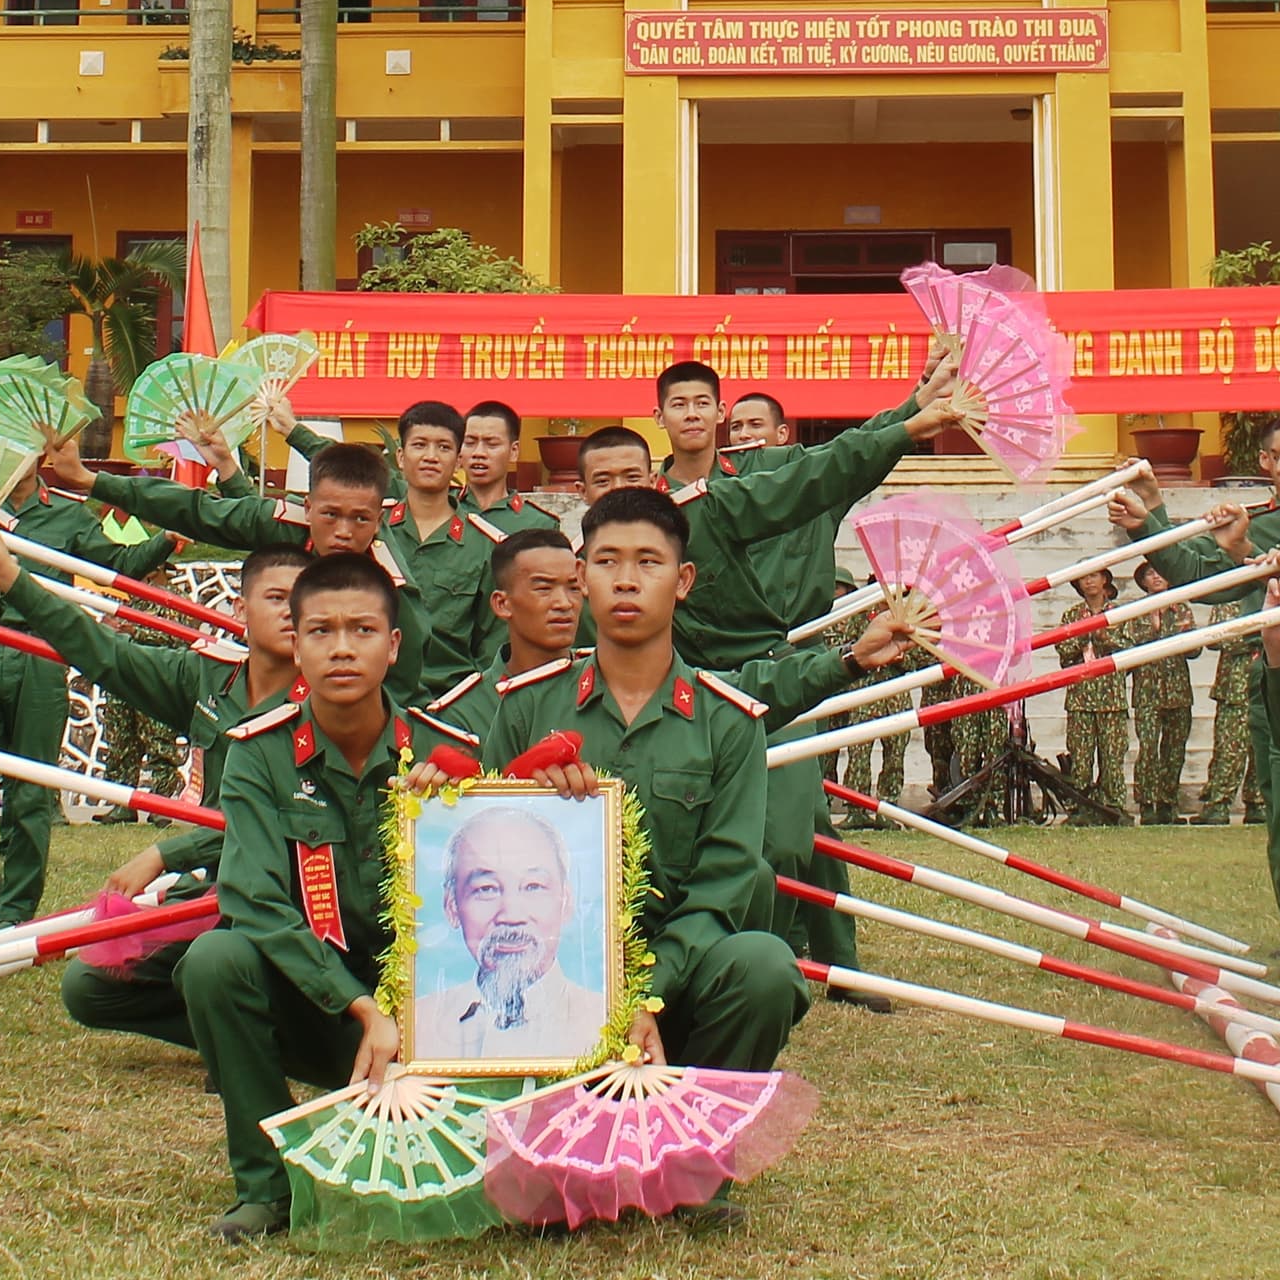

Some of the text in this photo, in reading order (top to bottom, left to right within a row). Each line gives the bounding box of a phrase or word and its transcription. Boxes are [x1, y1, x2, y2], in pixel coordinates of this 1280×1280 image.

[636, 15, 1098, 43] QUYẾT TÂM THỰC HIỆN TỐT PHONG TRÀO THI ĐUA
[672, 41, 705, 66] CHỦ,
[708, 43, 747, 64] ĐOÀN
[750, 40, 778, 66] KẾT,
[781, 43, 803, 64] TRÍ
[806, 42, 836, 67] TUỆ,
[840, 40, 858, 63] KỶ
[861, 44, 913, 65] CƯƠNG,
[916, 41, 945, 62] NÊU
[948, 43, 1000, 64] GƯƠNG,
[1003, 39, 1046, 64] QUYẾT
[387, 333, 441, 379] HUY
[460, 317, 565, 380] TRUYỀN
[584, 316, 674, 379] THỐNG
[693, 314, 769, 380] CỐNG
[786, 318, 851, 380] HIẾN
[868, 322, 910, 379] TÀI
[1109, 330, 1183, 376] DANH
[1199, 317, 1234, 385] BỘ
